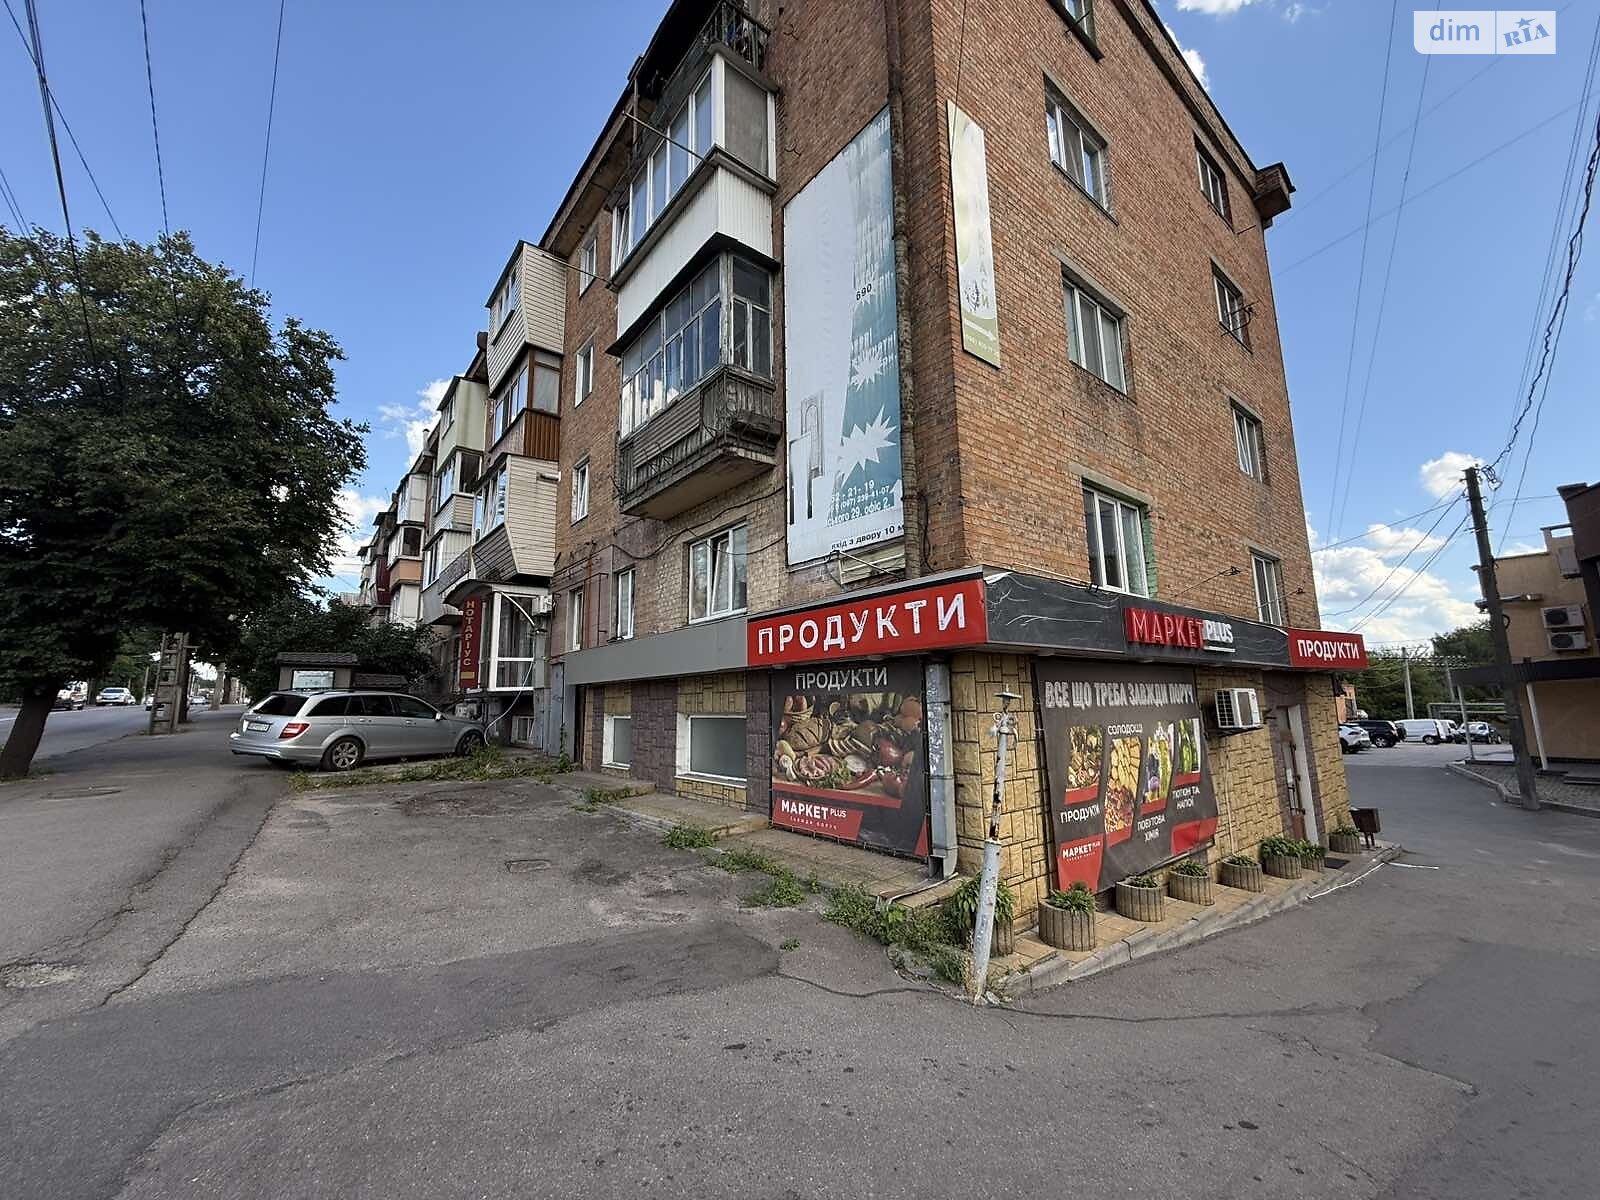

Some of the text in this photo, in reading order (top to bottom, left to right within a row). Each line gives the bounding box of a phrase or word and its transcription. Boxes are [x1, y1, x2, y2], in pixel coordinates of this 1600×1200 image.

[855, 530, 881, 545] двору
[884, 525, 895, 535] 10
[463, 600, 475, 666] НОТАРІУС
[758, 592, 966, 655] ПРОДУКТИ
[1130, 607, 1234, 648] МАРКЕТ PLUS
[1297, 639, 1361, 661] ПРОДУКТИ
[795, 667, 889, 691] ПРОДУКТИ
[1045, 681, 1195, 710] ВСЕ ЩО ТРЕБА ЗАВЖДИ ПОРУЧ
[781, 799, 847, 820] МАРКЕТ PLUS
[1060, 804, 1101, 824] ПРОДУКТИ
[1062, 843, 1092, 859] МАРКЕТ
